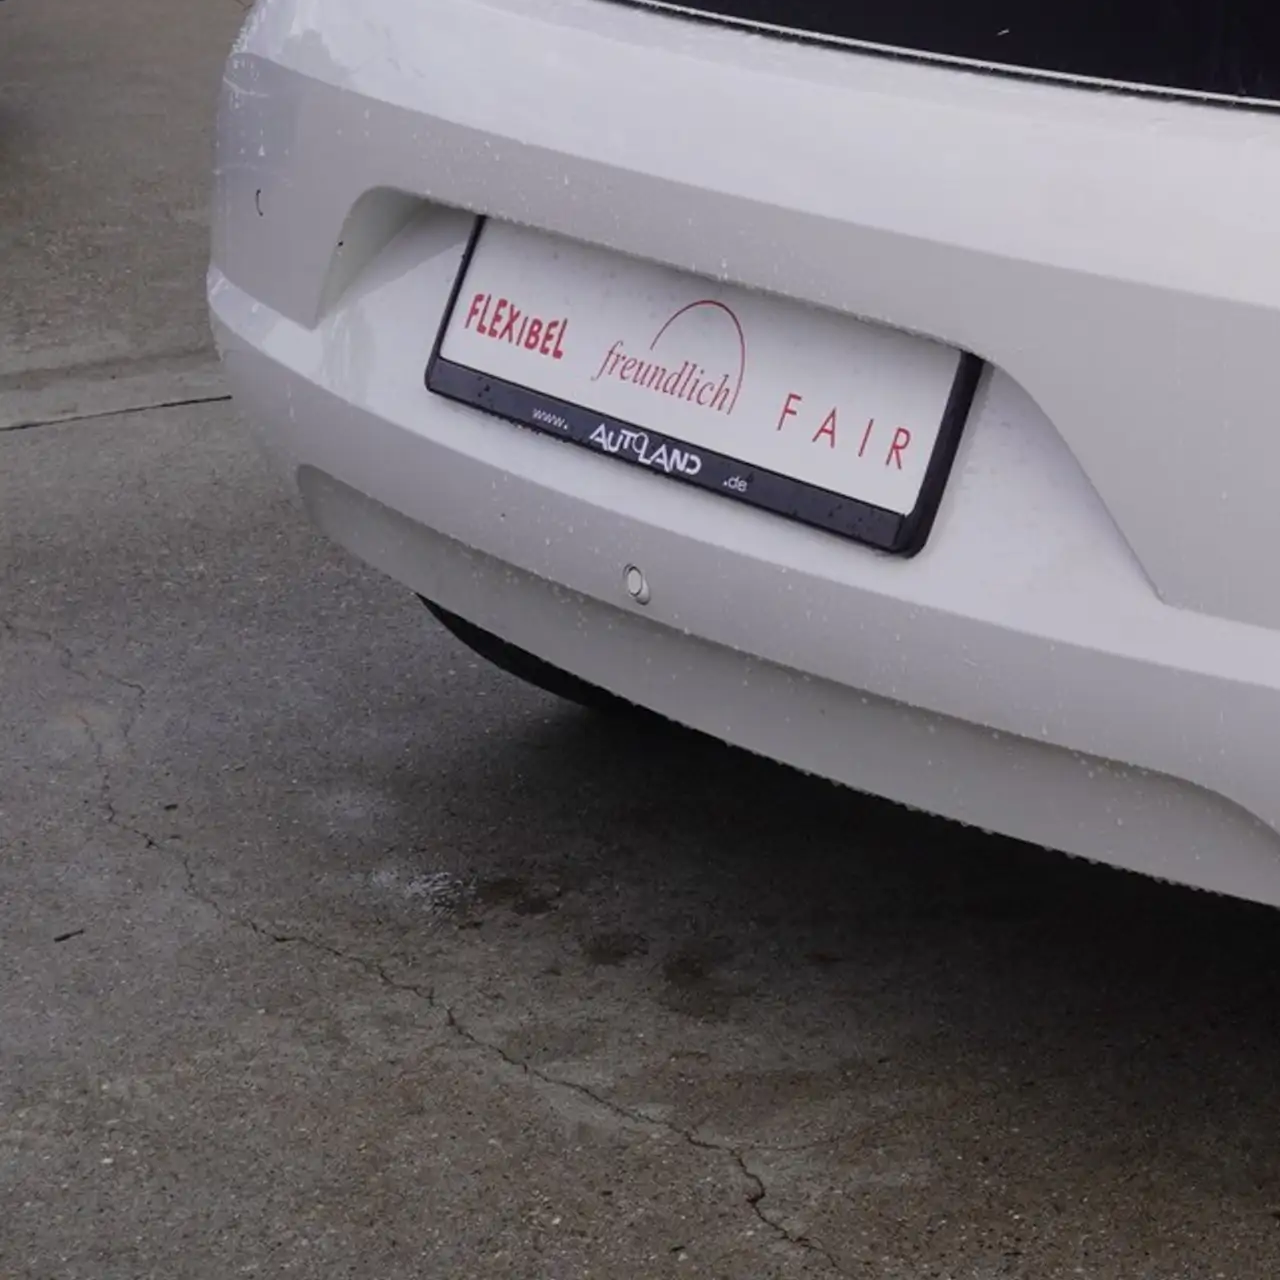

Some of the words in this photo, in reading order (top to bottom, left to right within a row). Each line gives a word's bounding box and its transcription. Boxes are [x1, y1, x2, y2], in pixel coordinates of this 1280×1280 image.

[465, 293, 568, 360] FLEXIBEL
[591, 340, 739, 416] freundlich
[532, 407, 570, 430] www.
[722, 475, 749, 493] .de
